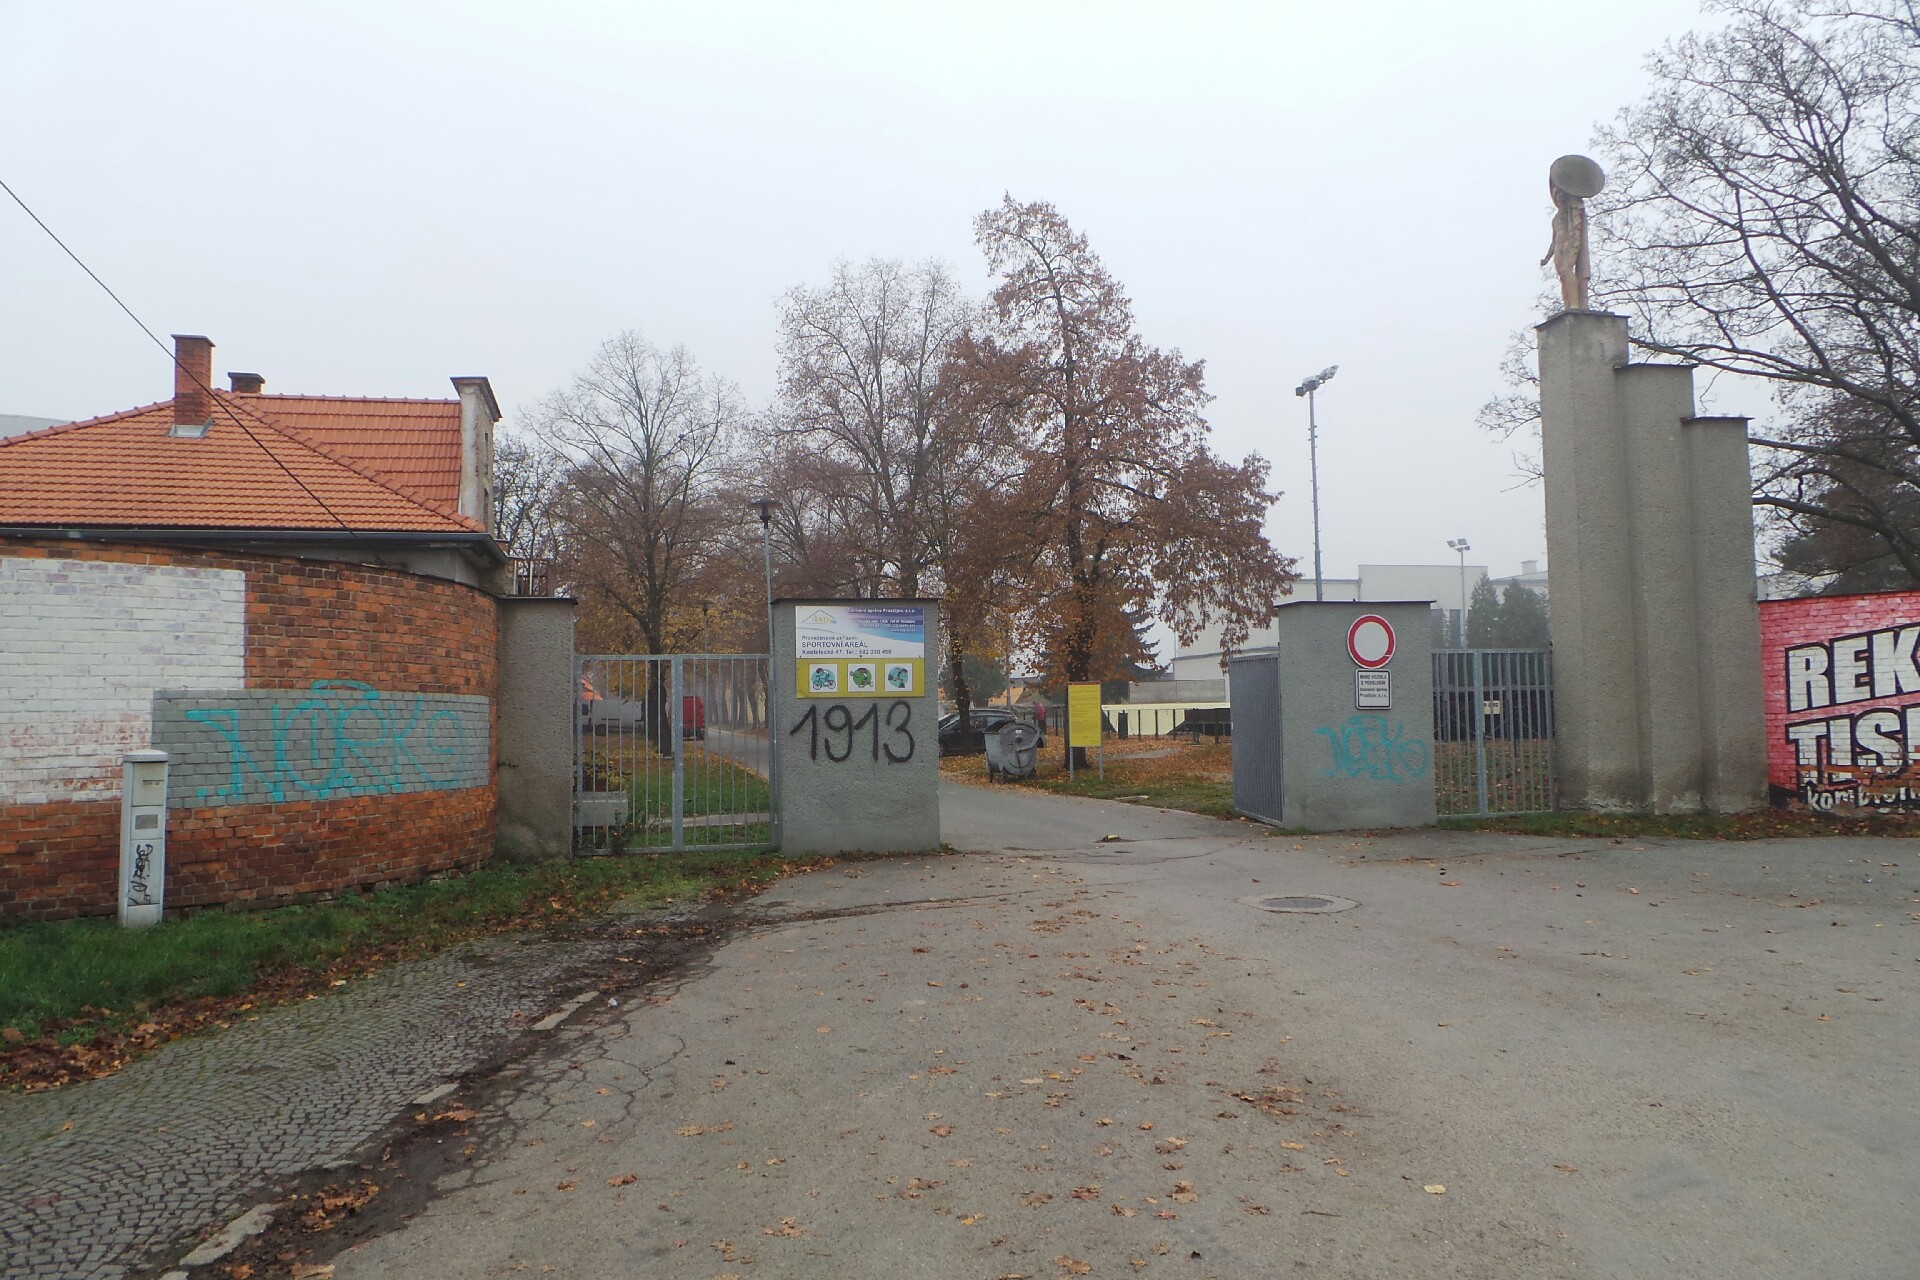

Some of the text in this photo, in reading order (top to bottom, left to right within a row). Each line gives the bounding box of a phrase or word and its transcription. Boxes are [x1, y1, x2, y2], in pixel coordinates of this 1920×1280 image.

[801, 640, 868, 648] SPORTOVNÍ AREÁL
[788, 700, 916, 764] 1913
[1785, 703, 1920, 786] TIS
